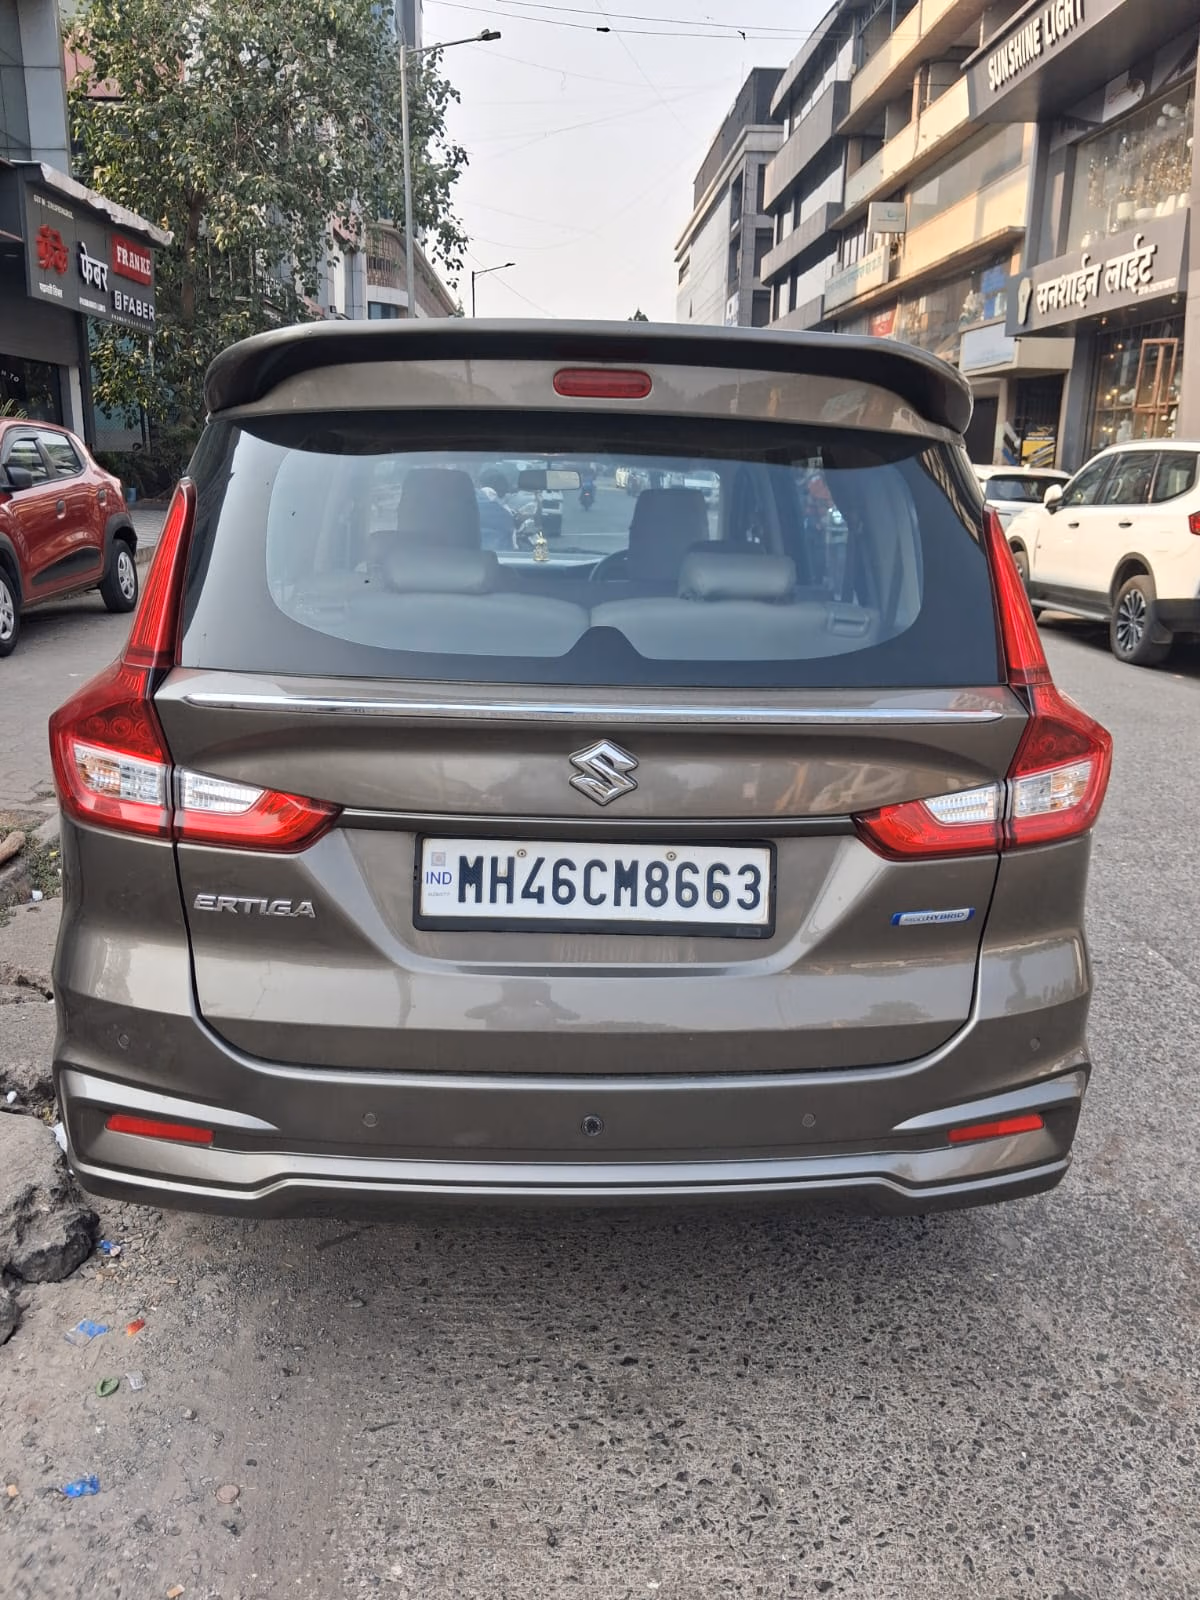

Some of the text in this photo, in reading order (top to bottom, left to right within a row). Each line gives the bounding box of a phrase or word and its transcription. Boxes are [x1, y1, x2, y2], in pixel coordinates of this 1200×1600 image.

[988, 17, 1041, 91] SUNSHINE
[80, 241, 108, 292] फेबर
[117, 245, 151, 276] FRANKE
[123, 294, 155, 321] FABER
[425, 871, 453, 885] IND
[458, 854, 762, 911] MH46CM8663
[193, 894, 316, 919] ERTIGA
